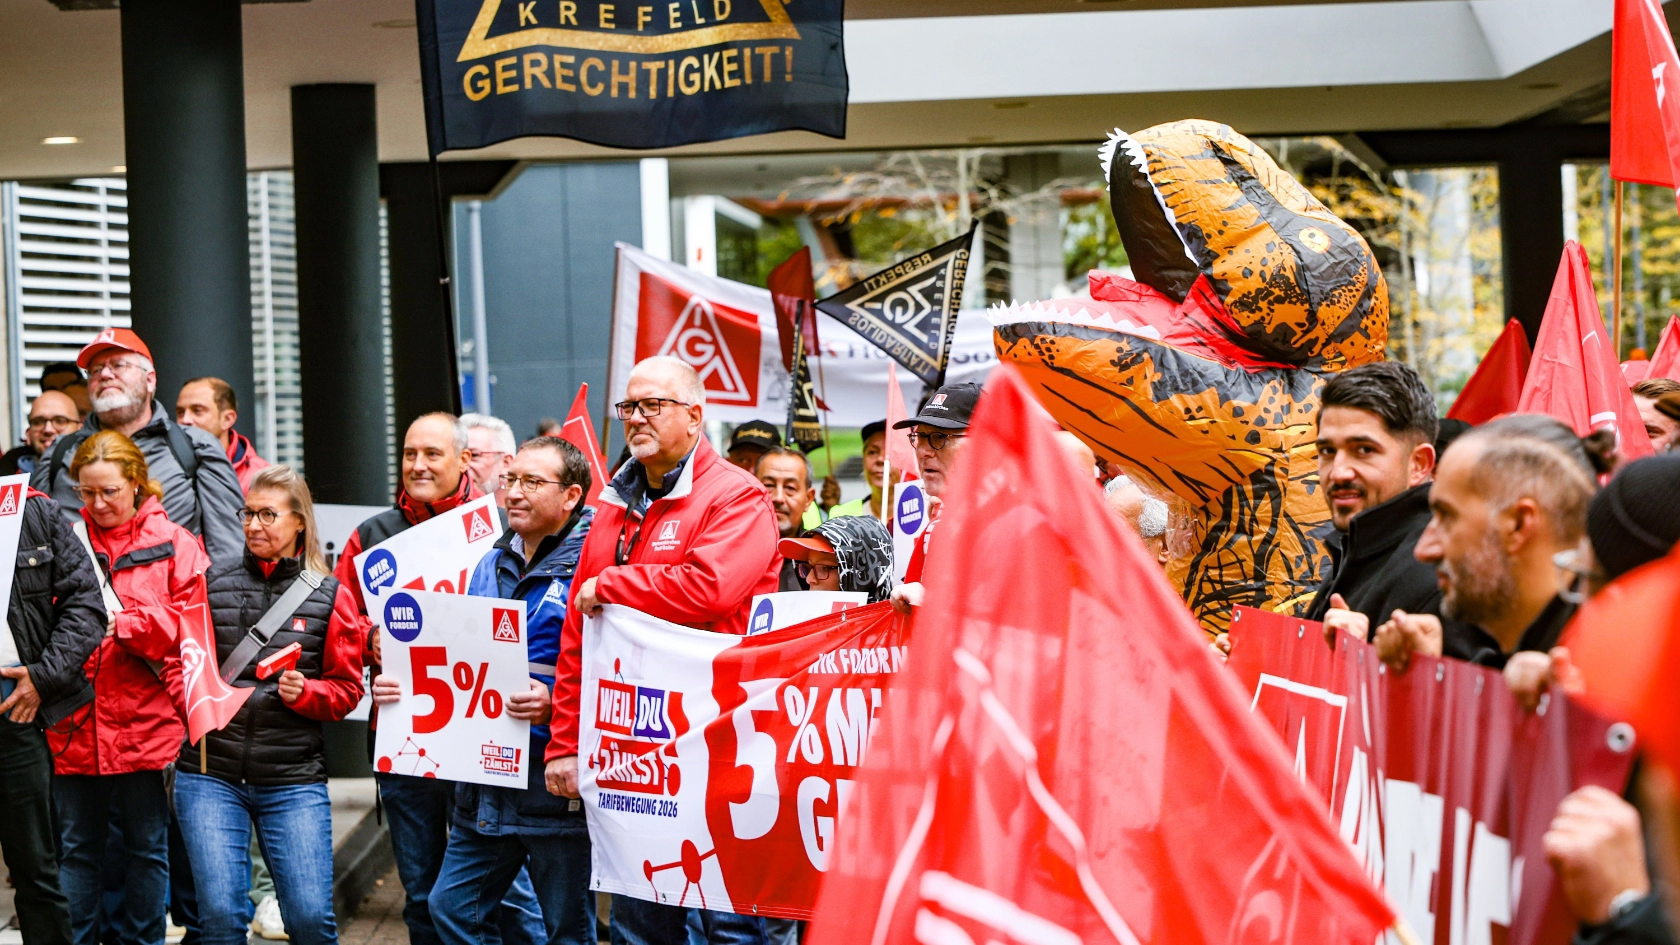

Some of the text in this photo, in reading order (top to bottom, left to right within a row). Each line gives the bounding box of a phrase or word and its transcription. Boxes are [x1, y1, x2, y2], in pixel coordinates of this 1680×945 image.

[518, 0, 732, 32] KREFELD
[462, 45, 795, 102] GERECHTIGKEIT!
[367, 558, 390, 580] WIR
[369, 568, 395, 590] FORDERN
[389, 621, 418, 630] FORDERN
[390, 606, 415, 621] WIR
[496, 611, 518, 640] IGM
[409, 646, 503, 734] 5%
[599, 687, 663, 732] WEIL DU
[483, 745, 513, 758] WEIL DU
[598, 792, 678, 818] TARIFBEWEGUNG 2026
